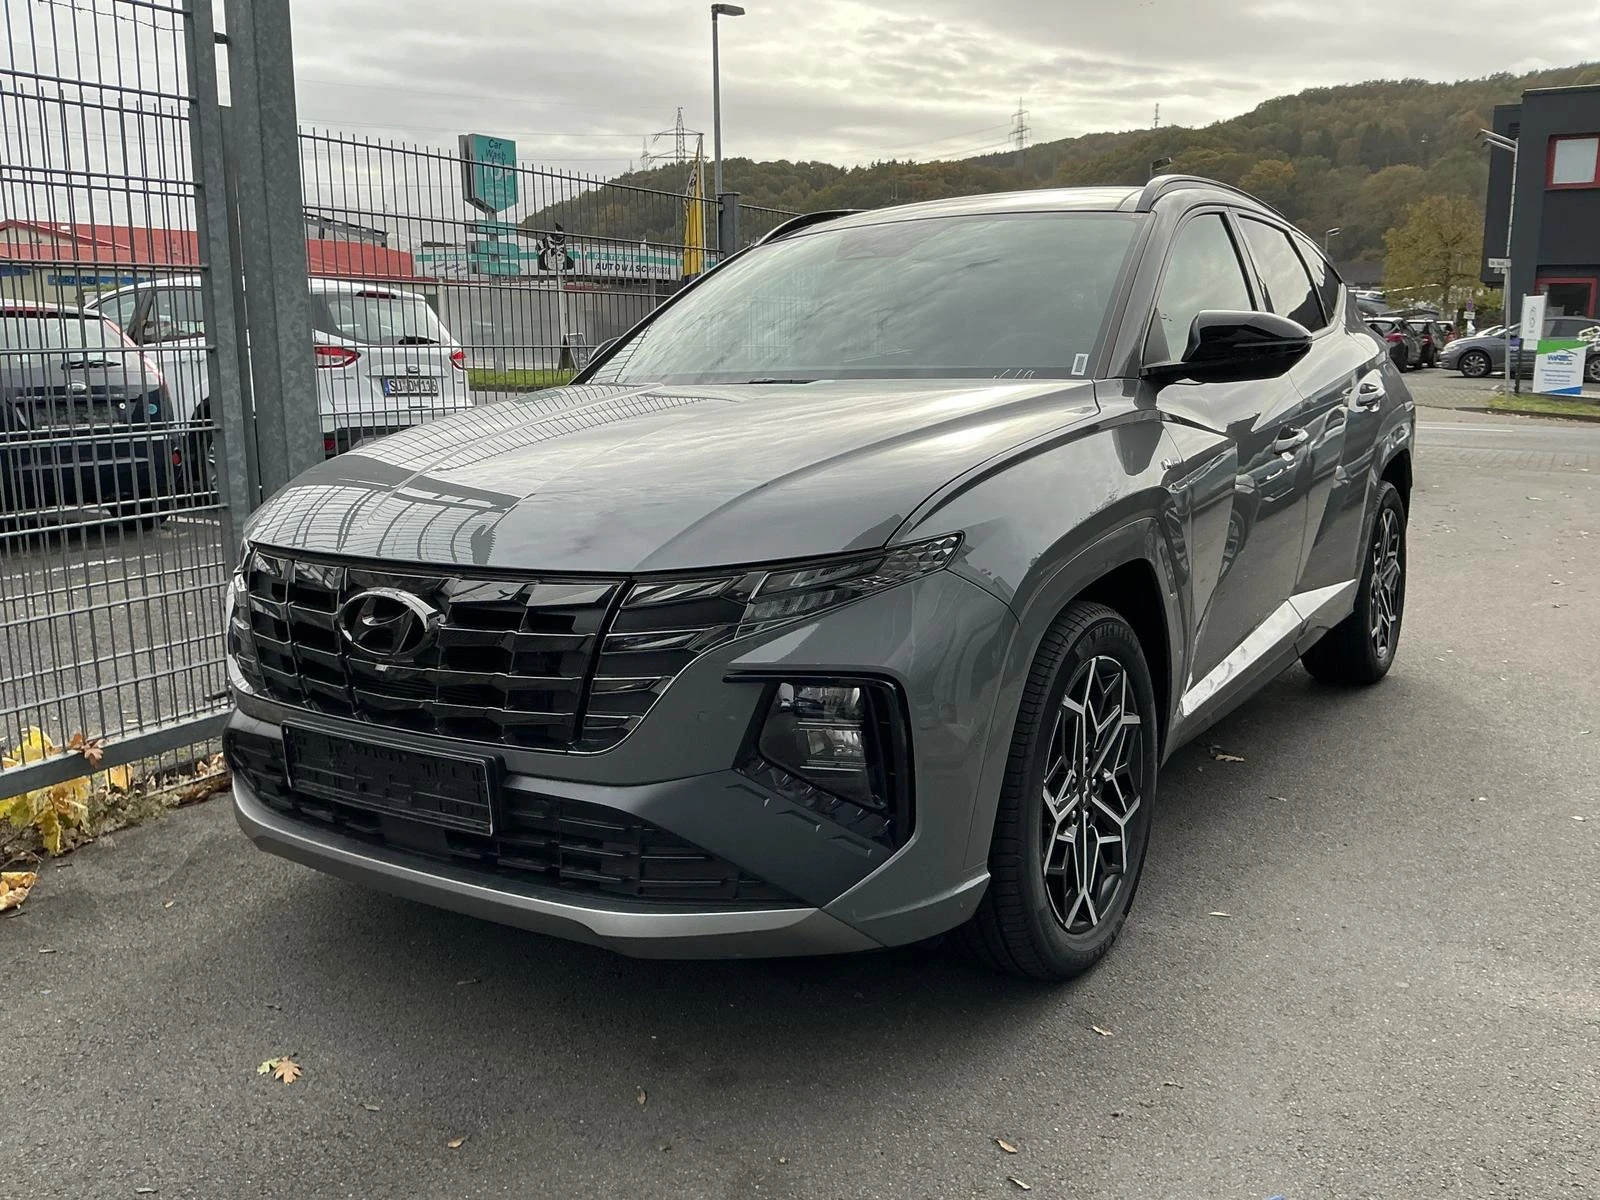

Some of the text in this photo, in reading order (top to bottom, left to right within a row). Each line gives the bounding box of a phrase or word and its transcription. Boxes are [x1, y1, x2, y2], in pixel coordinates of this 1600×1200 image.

[489, 139, 503, 150] Car
[486, 148, 507, 160] Wash
[389, 380, 403, 392] SU
